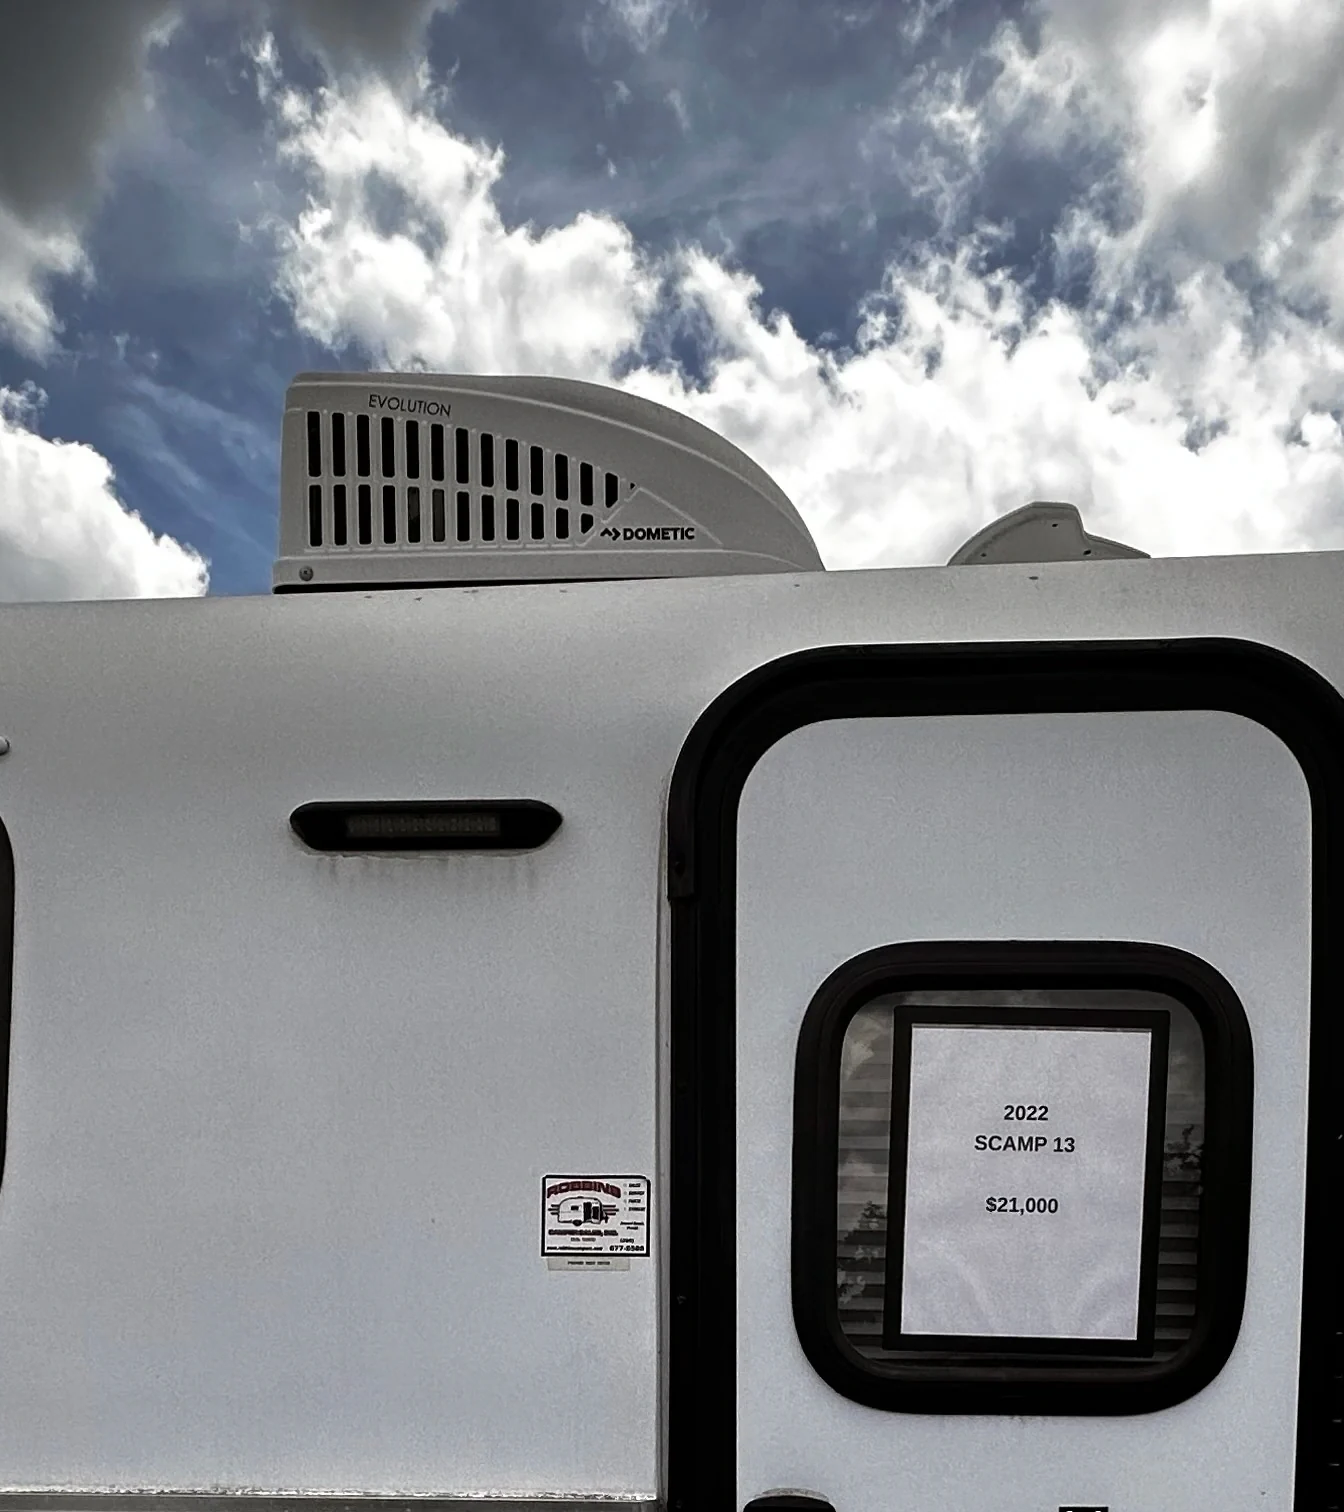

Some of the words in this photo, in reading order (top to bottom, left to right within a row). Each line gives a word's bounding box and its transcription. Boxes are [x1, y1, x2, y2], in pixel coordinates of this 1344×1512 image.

[368, 394, 451, 417] EVOLUTION
[623, 527, 695, 541] DOMETIC
[1003, 1105, 1049, 1121] 2022
[974, 1135, 1048, 1152] SCAMP
[1053, 1137, 1076, 1153] 13
[985, 1197, 1059, 1216] $21,000
